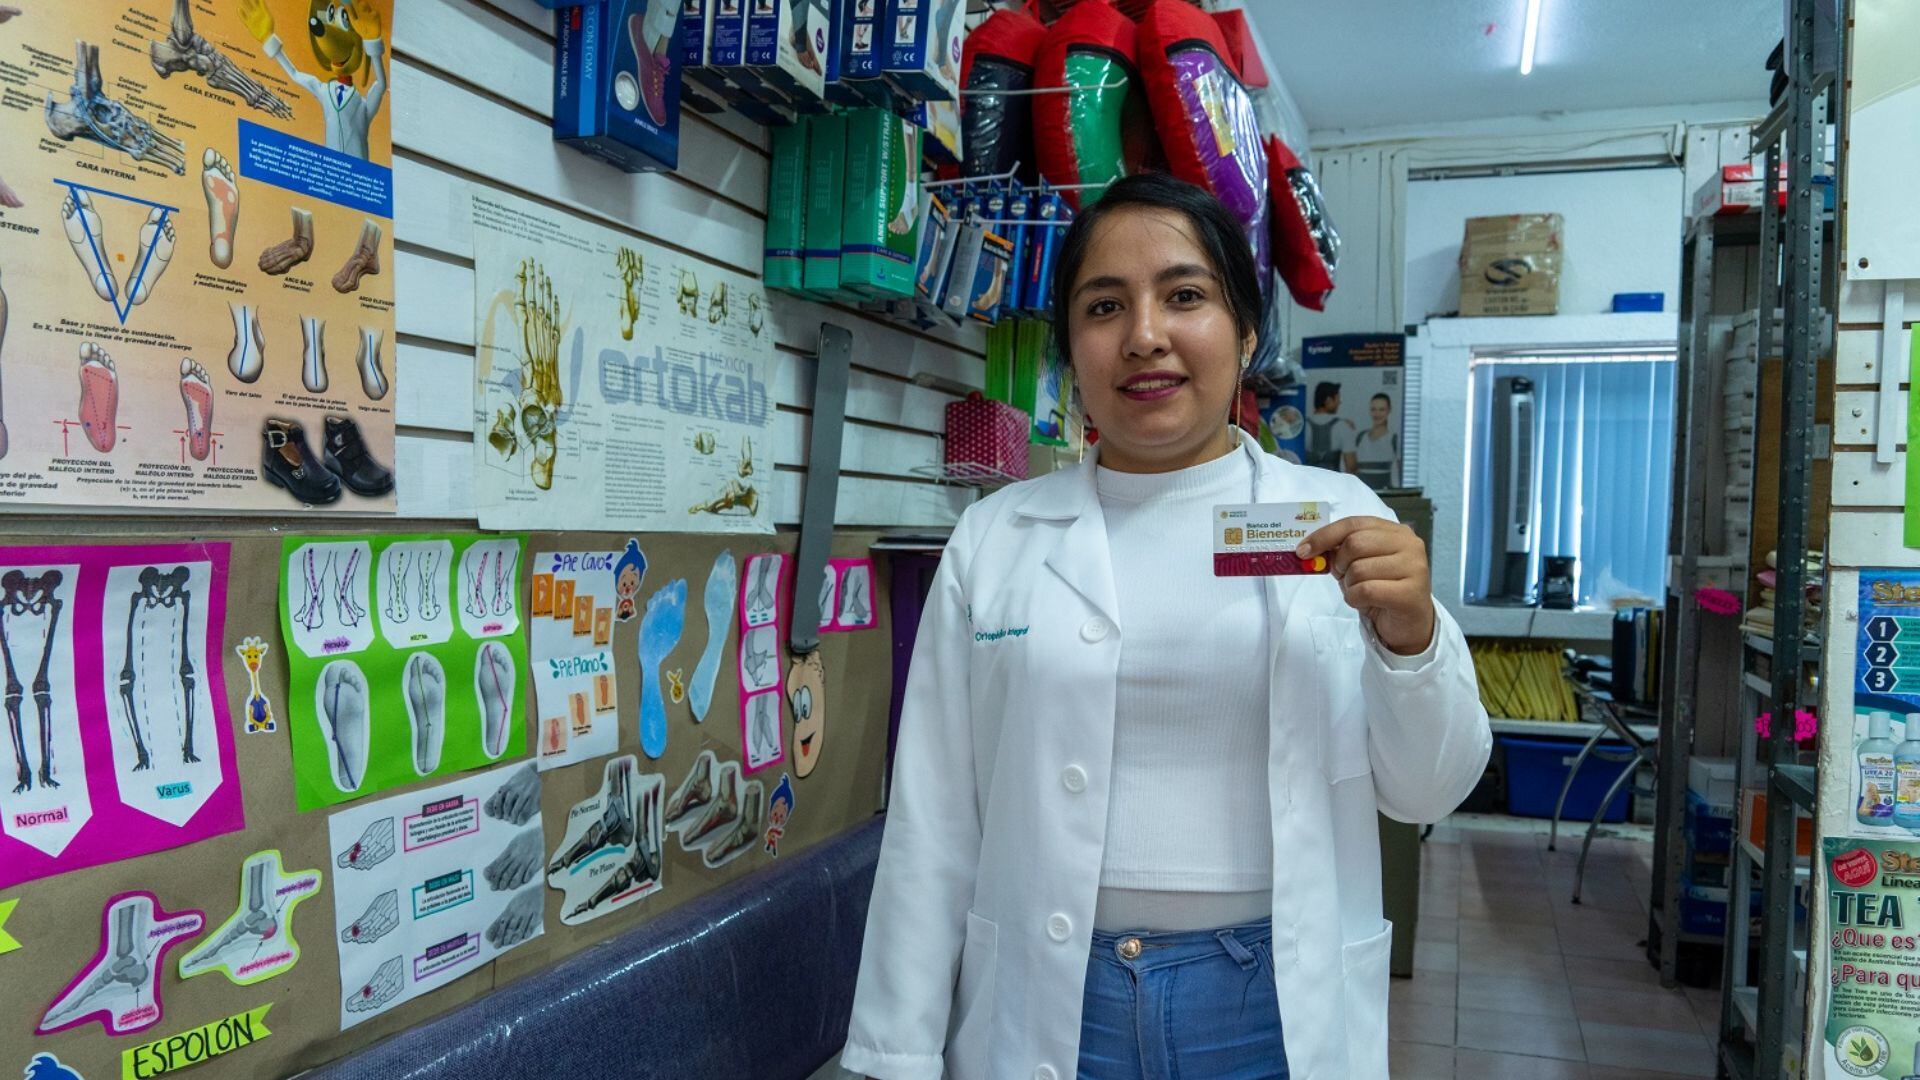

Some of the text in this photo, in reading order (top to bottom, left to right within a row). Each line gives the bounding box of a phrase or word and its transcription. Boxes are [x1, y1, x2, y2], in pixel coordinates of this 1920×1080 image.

[561, 50, 569, 75] ANKLE
[184, 84, 236, 108] CARA EXTERNA
[76, 161, 136, 182] CARA INTERNA
[877, 112, 891, 244] ANKLE SUPPORT W/STRAP
[60, 318, 79, 327] Base
[121, 327, 130, 335] de
[32, 323, 43, 331] En
[114, 334, 123, 342] de
[124, 336, 156, 347] gravedad
[157, 340, 168, 348] del
[169, 343, 192, 352] cuerpo
[599, 345, 768, 428] ortokab
[52, 458, 97, 467] PROYECCIÓN
[84, 467, 115, 475] INTERNO
[138, 463, 179, 471] PROYECCIÓN
[12, 472, 43, 482] del pie.
[19, 482, 58, 491] gravedad
[1246, 521, 1281, 530] Banco del
[1246, 528, 1307, 540] Bienestar
[561, 552, 607, 573] Pie Cavo
[1879, 621, 1887, 637] 1
[1876, 646, 1887, 663] 2
[559, 657, 600, 678] Pie Plano
[1874, 671, 1885, 688] 3
[156, 783, 191, 798] Varus
[580, 800, 600, 816] Normal
[16, 807, 68, 827] Normal
[590, 860, 616, 878] Pie Plano
[1832, 890, 1904, 929] TEA
[1830, 964, 1889, 986] ¿Para
[132, 1011, 255, 1080] ESPOLÓN
